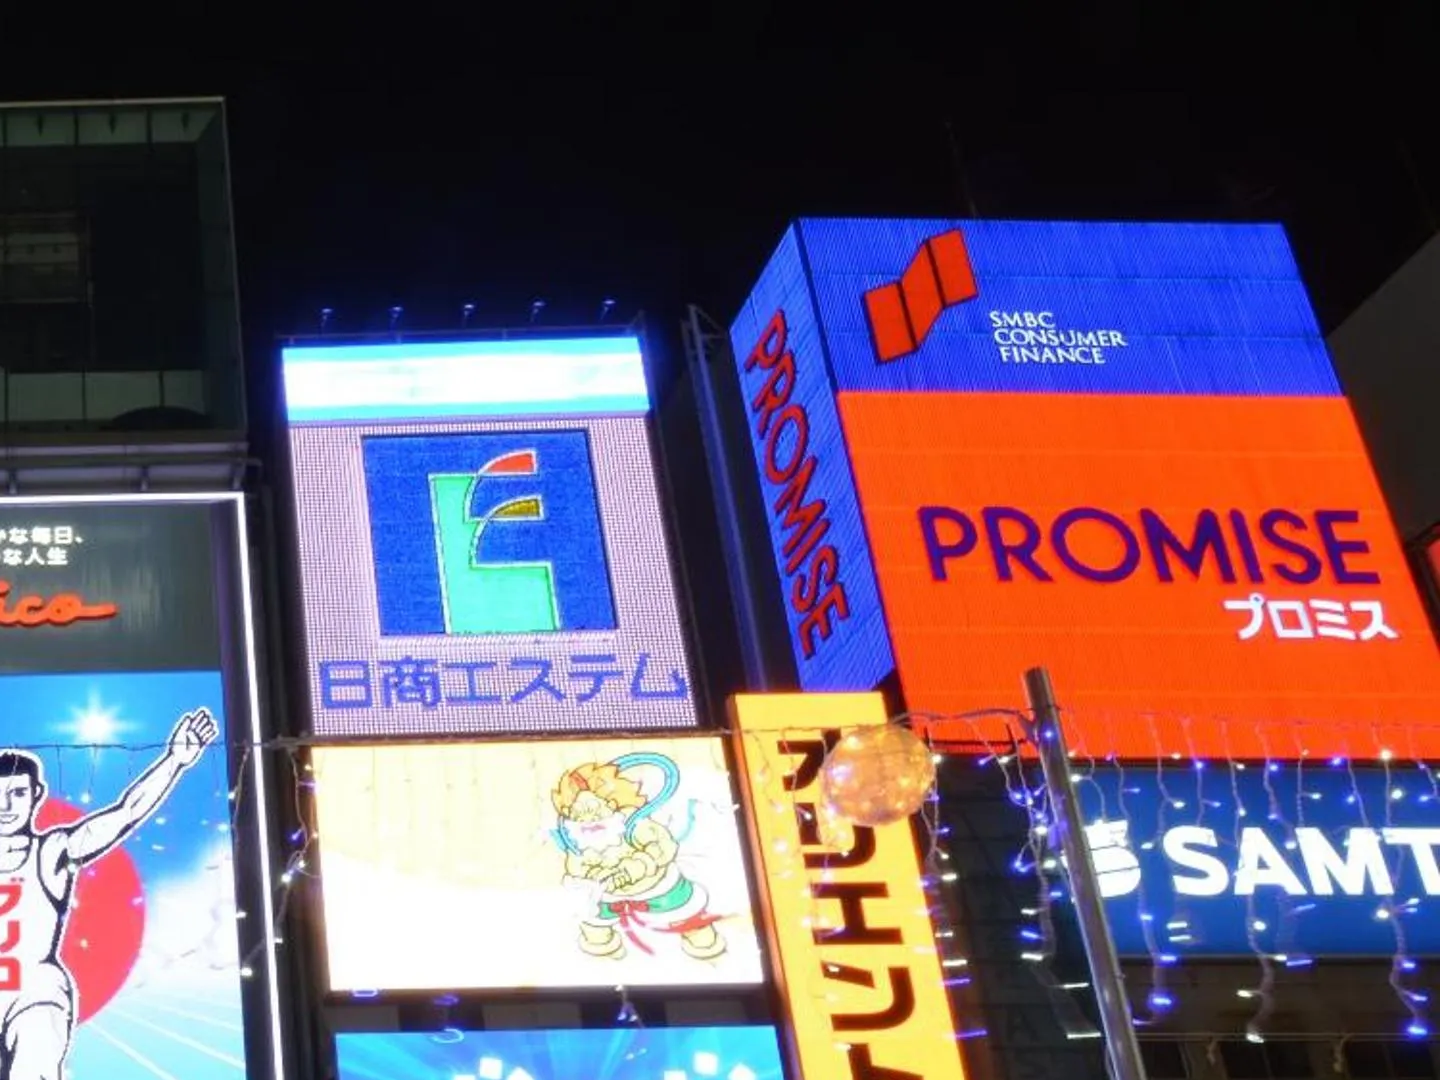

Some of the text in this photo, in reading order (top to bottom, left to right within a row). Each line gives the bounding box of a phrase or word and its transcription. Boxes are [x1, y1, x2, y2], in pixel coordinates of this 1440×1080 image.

[988, 310, 1055, 329] SMBC
[993, 329, 1128, 348] CONSUMER
[999, 347, 1107, 365] FINANCE
[745, 308, 851, 661] PROMISE
[916, 505, 1381, 585] PROMISE
[1223, 592, 1399, 641] プロミス
[318, 652, 691, 711] 日商エステム
